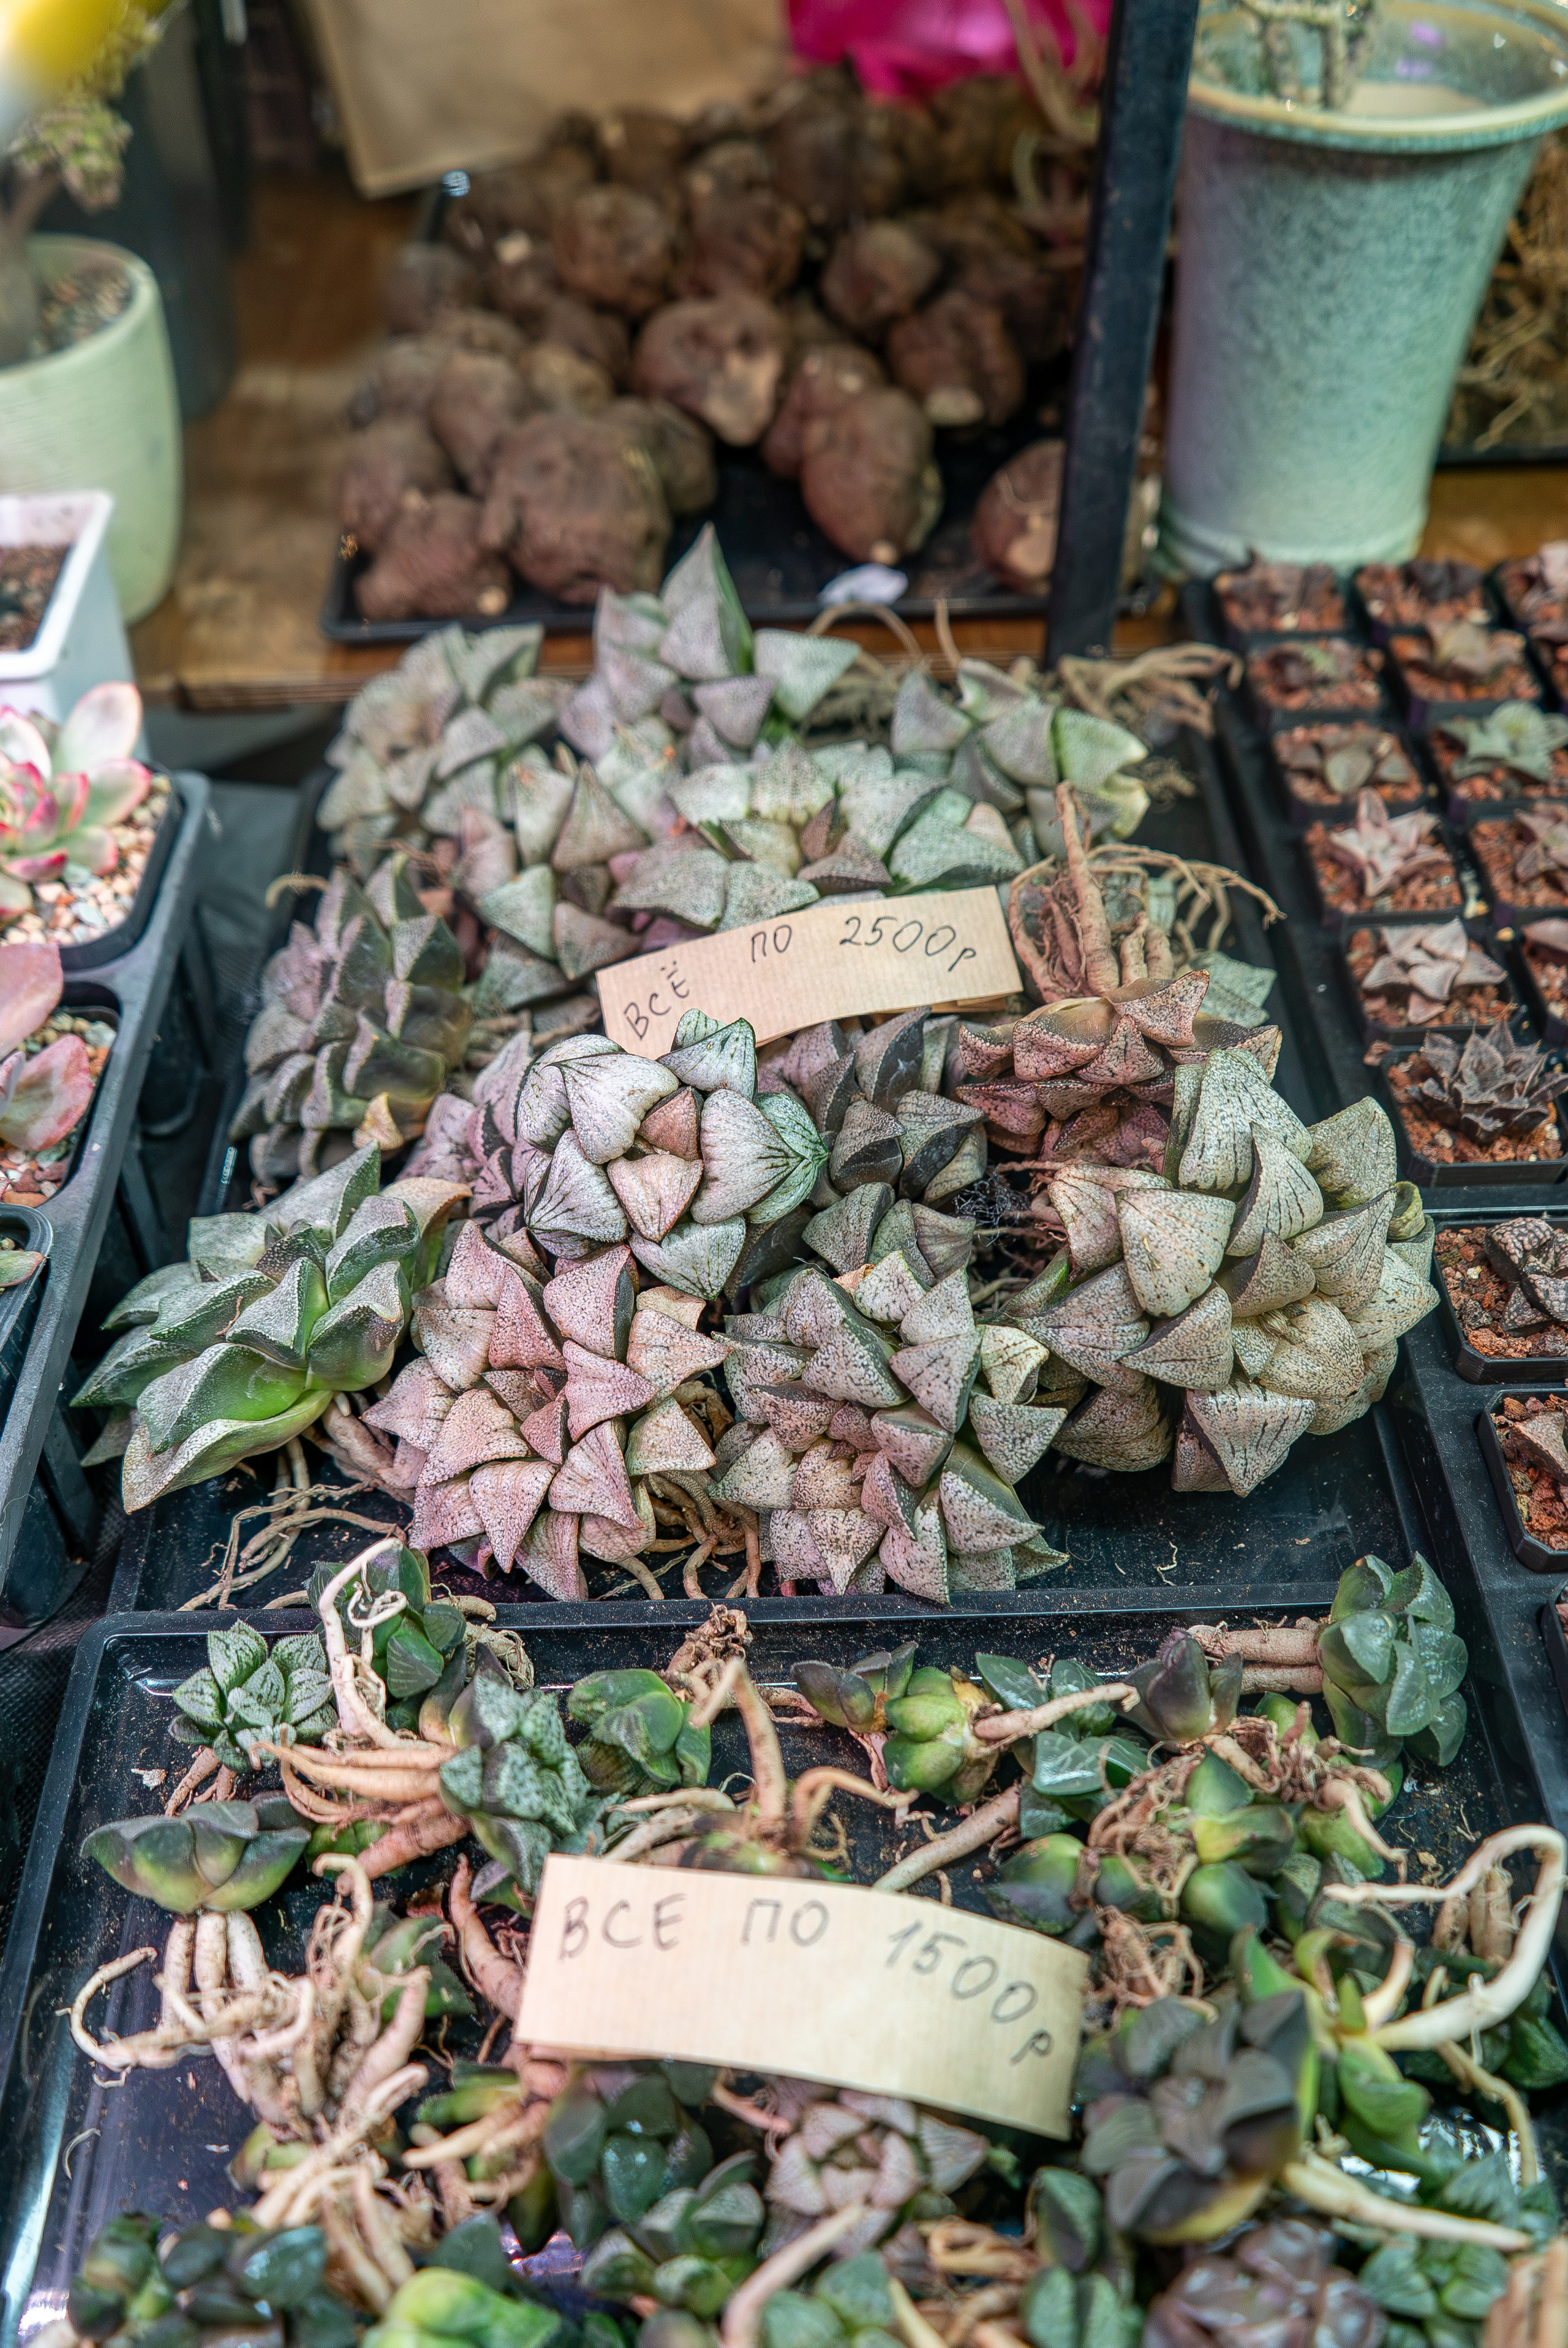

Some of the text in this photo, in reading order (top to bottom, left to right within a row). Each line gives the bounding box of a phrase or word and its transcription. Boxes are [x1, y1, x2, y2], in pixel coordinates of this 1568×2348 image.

[624, 960, 690, 1041] ВСЁ
[558, 1892, 687, 1960] ВСЕ
[739, 1897, 831, 1947] ПО
